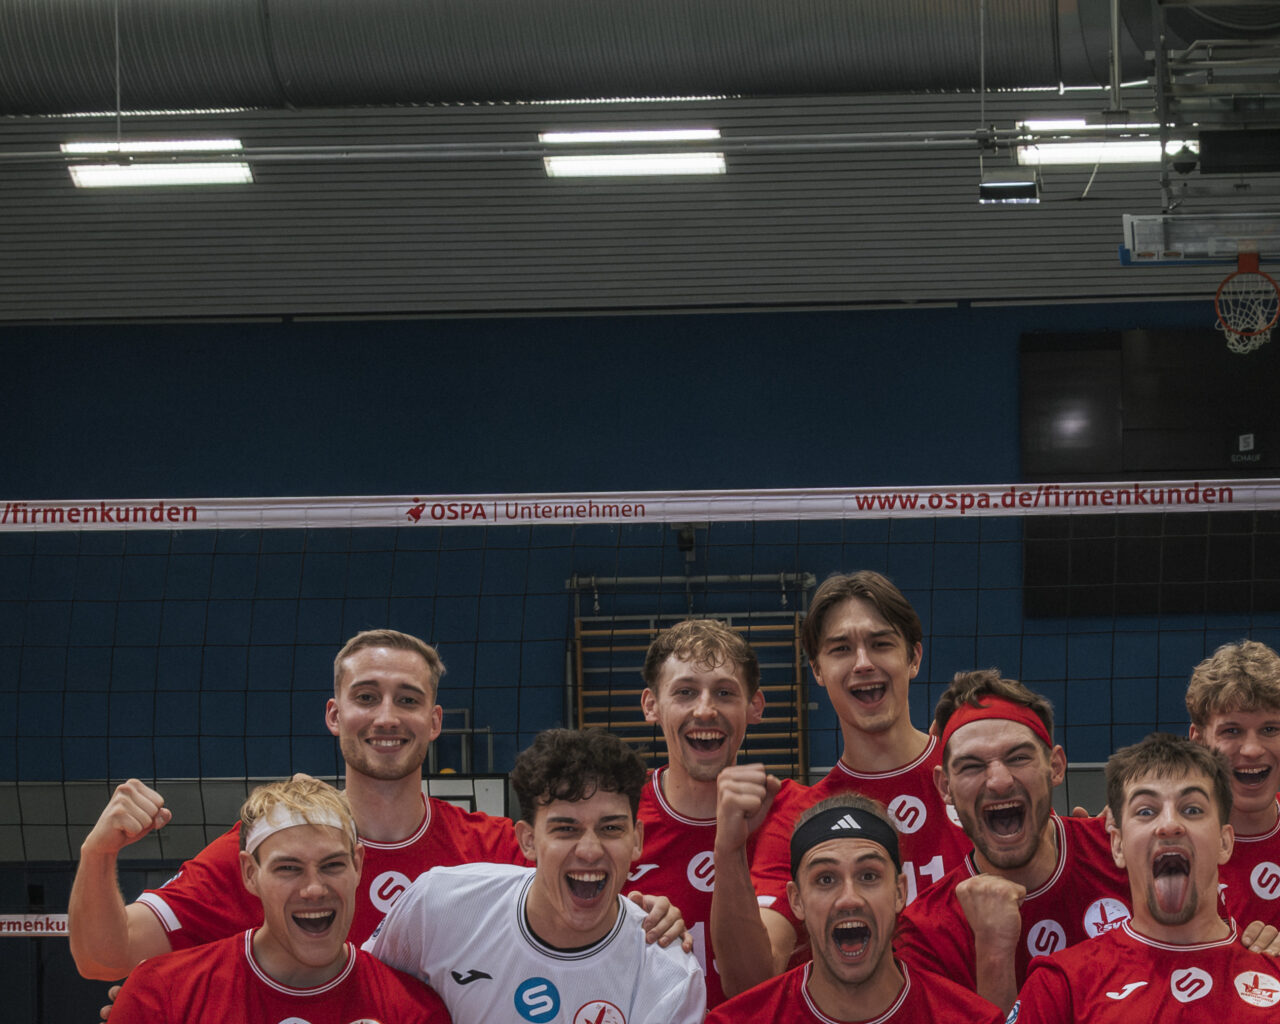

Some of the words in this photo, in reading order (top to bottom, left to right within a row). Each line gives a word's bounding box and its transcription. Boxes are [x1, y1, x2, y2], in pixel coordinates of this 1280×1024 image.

[430, 503, 487, 521] OSPA
[505, 500, 646, 520] Unternehmen
[855, 482, 1234, 514] www.ospa.de/firmenkunden
